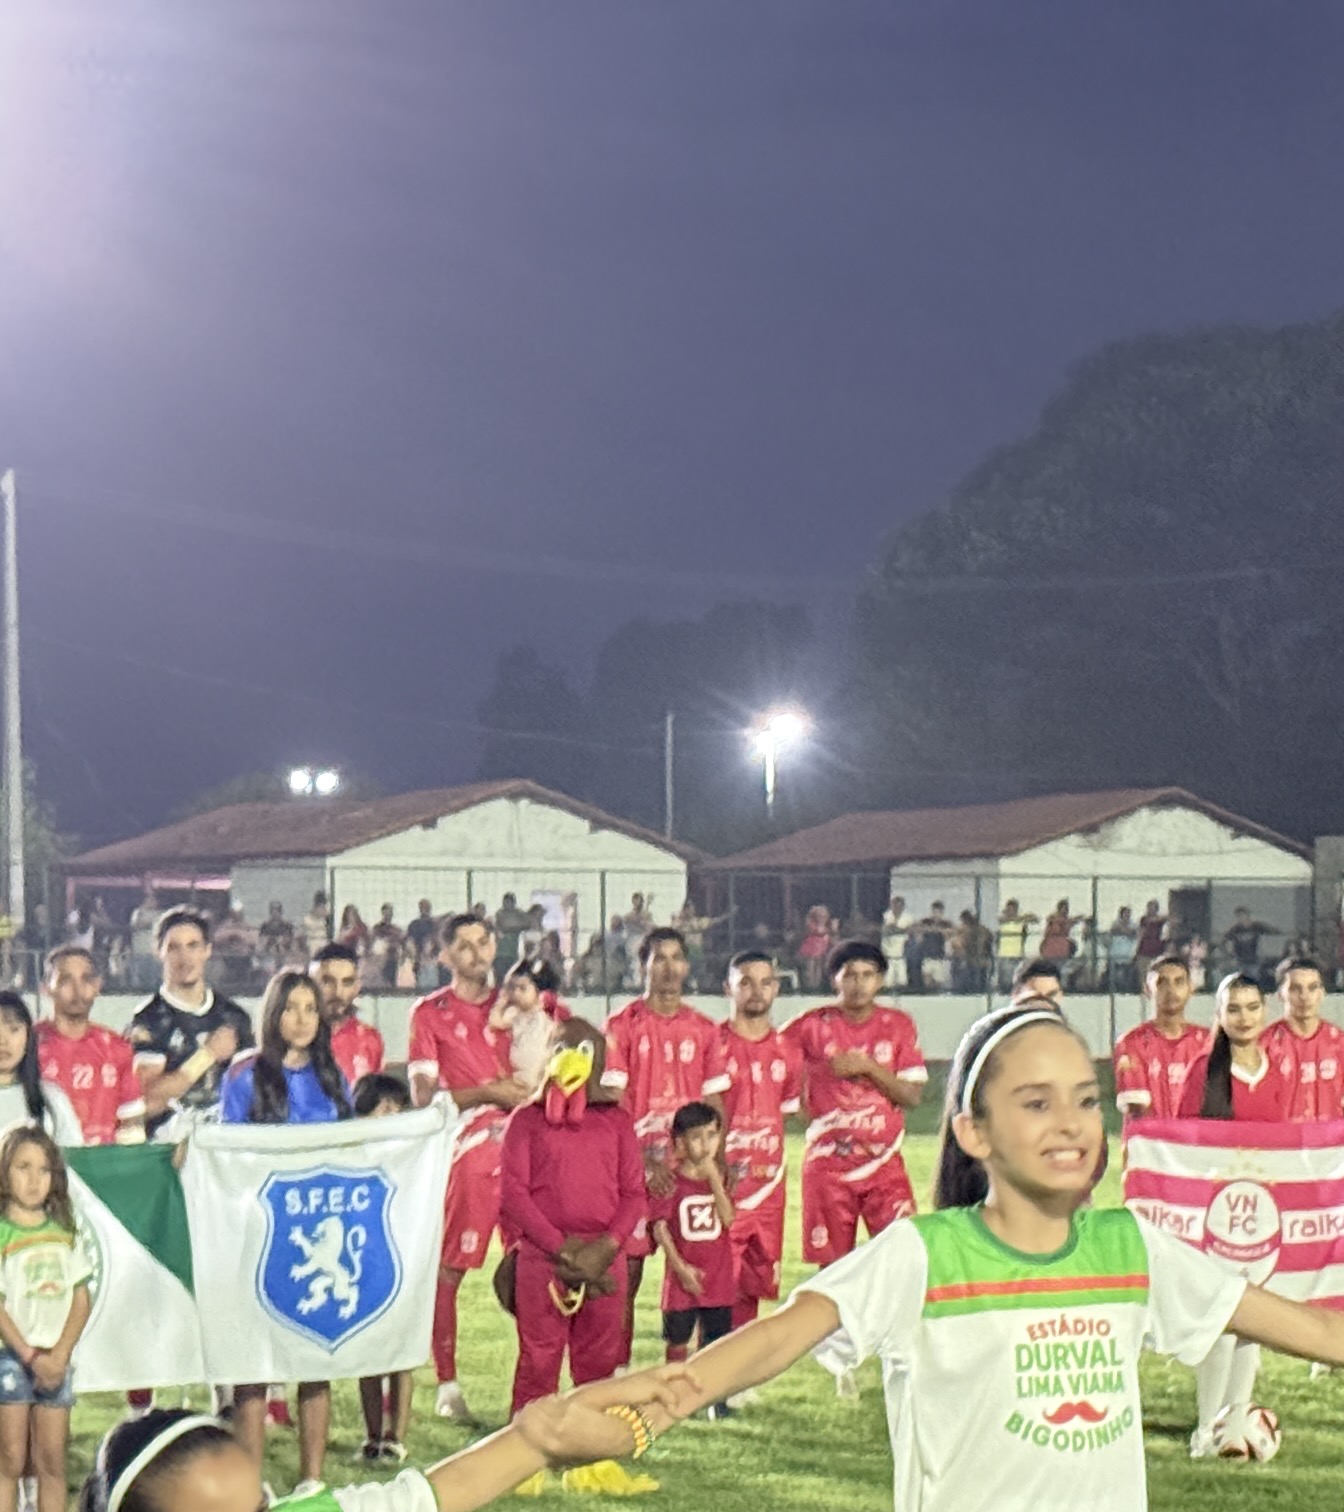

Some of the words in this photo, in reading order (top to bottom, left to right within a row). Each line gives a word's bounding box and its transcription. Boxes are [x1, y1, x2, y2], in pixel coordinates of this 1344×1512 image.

[72, 1063, 94, 1089] 22
[1225, 1193, 1258, 1213] VN
[1229, 1215, 1258, 1236] FC
[1026, 1313, 1111, 1342] ESTÁDIO
[1014, 1337, 1124, 1373] DURVAL
[1016, 1374, 1065, 1399] LIMA
[1067, 1370, 1125, 1396] VIANA
[1005, 1405, 1134, 1452] BIGODINHO
